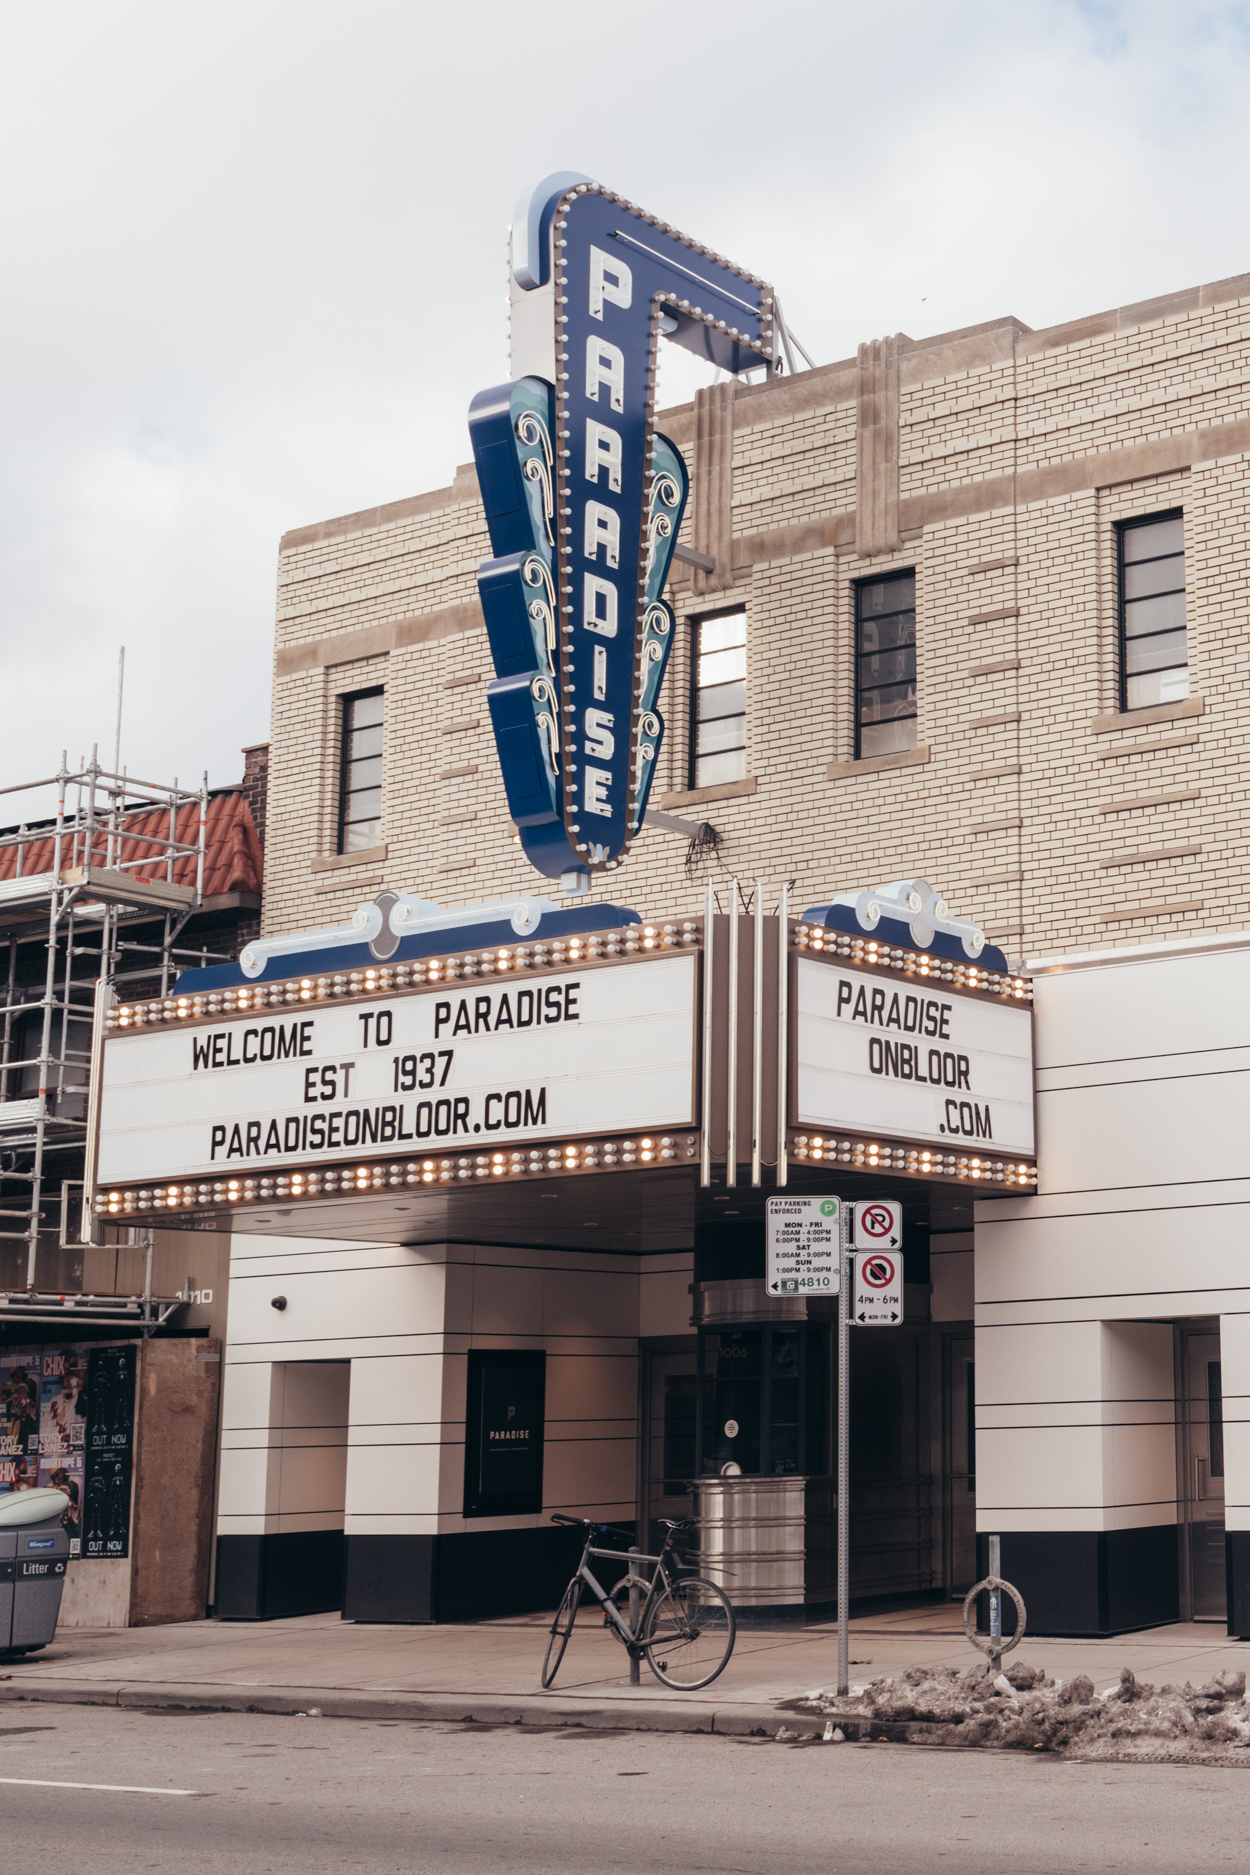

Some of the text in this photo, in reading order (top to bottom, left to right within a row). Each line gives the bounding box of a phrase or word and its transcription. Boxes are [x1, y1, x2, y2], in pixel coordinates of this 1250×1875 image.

[583, 244, 632, 818] PARADISE
[837, 980, 952, 1040] PARADISE
[192, 983, 581, 1071] WELCOME TO PARADISE
[869, 1037, 971, 1091] ONBLOOR
[304, 1050, 454, 1104] EST 1937
[210, 1087, 547, 1161] PARADISEONBLOOR.COM
[939, 1099, 993, 1139] .COM
[799, 1277, 830, 1287] 4810
[719, 1347, 747, 1359] 1006
[43, 1356, 65, 1376] CHIX
[39, 1433, 64, 1444] TORY
[92, 1433, 127, 1445] OUT NOW
[489, 1430, 530, 1440] PARADISE
[0, 1444, 23, 1455] ANEZ
[38, 1443, 68, 1454] LANEZ
[0, 1462, 16, 1482] HIX
[88, 1541, 123, 1551] OUT NOW
[23, 1563, 49, 1575] Litter
